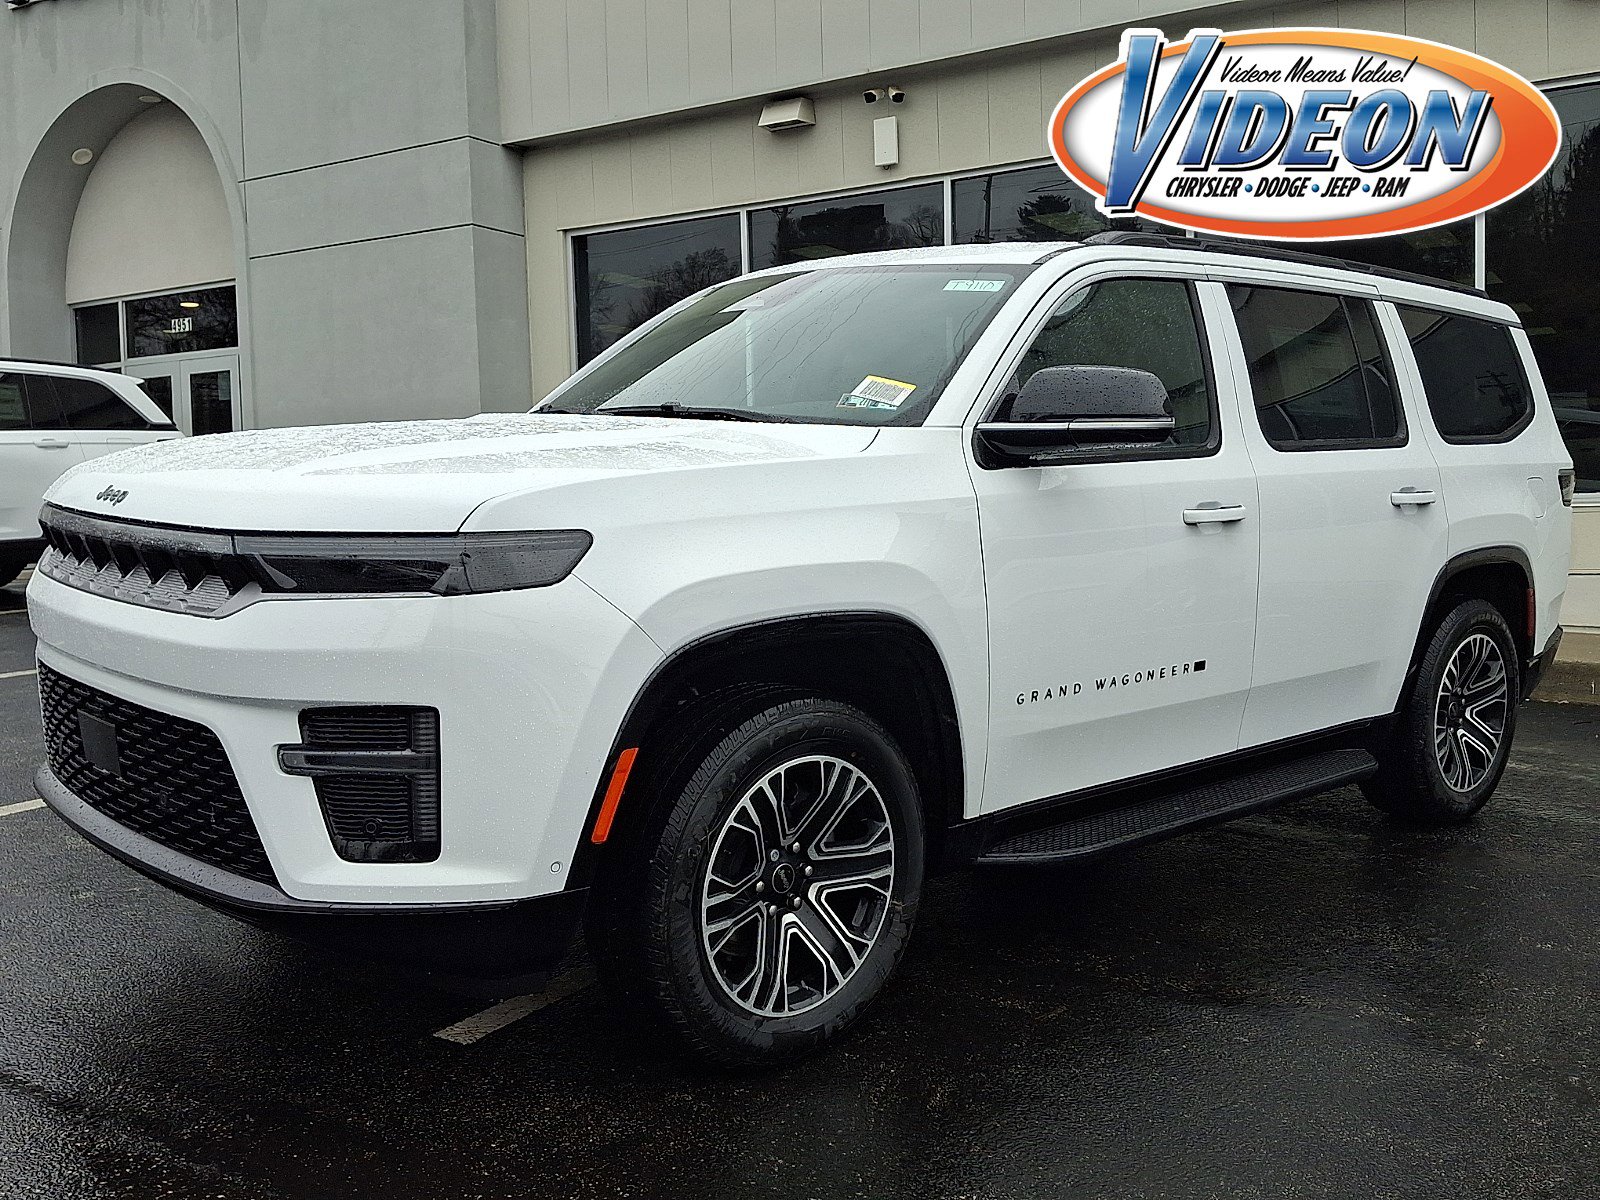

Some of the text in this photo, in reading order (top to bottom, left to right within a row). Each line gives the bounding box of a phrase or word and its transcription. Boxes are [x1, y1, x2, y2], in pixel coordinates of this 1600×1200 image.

[171, 318, 192, 332] 4951
[96, 484, 129, 507] Jeep
[1016, 662, 1190, 706] GRAND WAGONEER
